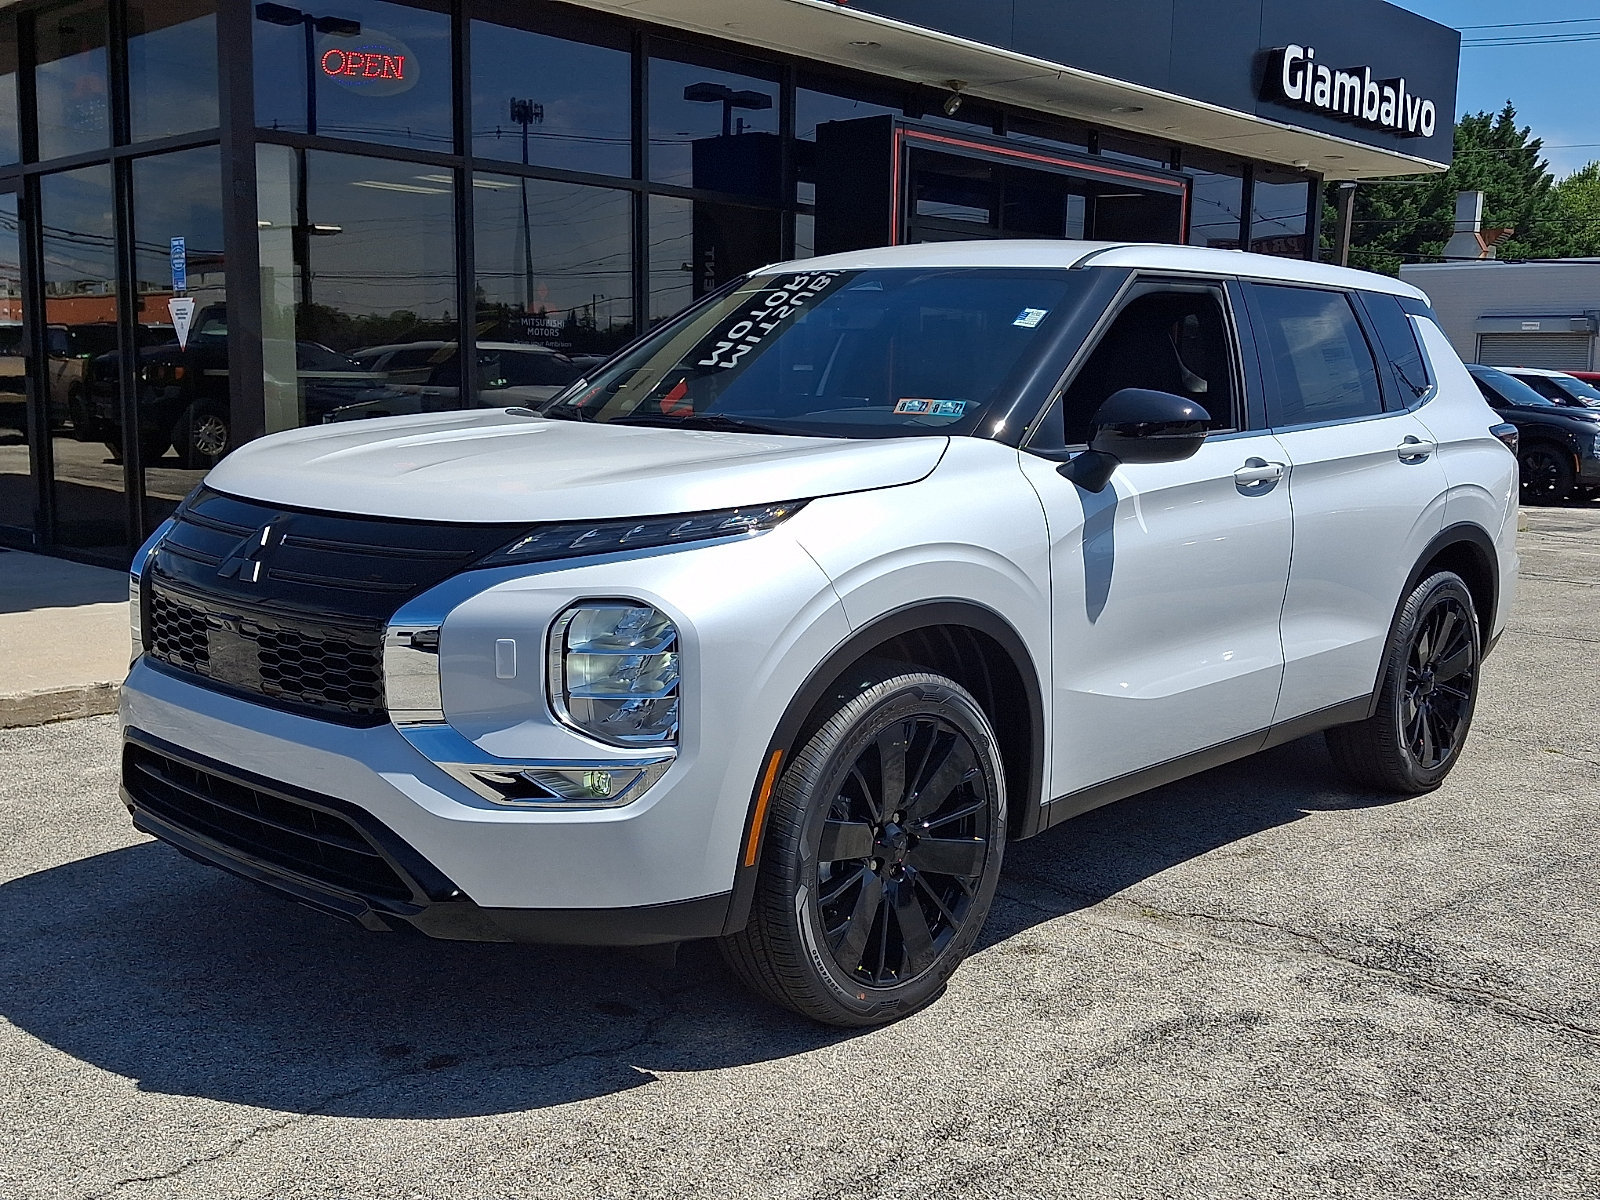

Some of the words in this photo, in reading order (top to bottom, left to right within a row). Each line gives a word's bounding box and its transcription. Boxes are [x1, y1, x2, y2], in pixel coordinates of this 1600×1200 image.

[321, 48, 405, 80] OPEN
[1282, 43, 1436, 138] Giambalvo
[521, 318, 564, 328] MITSUBISHI
[527, 328, 560, 336] MOTORS
[900, 402, 906, 411] 8
[919, 402, 928, 412] 27
[933, 404, 939, 413] 8
[953, 403, 962, 413] 27
